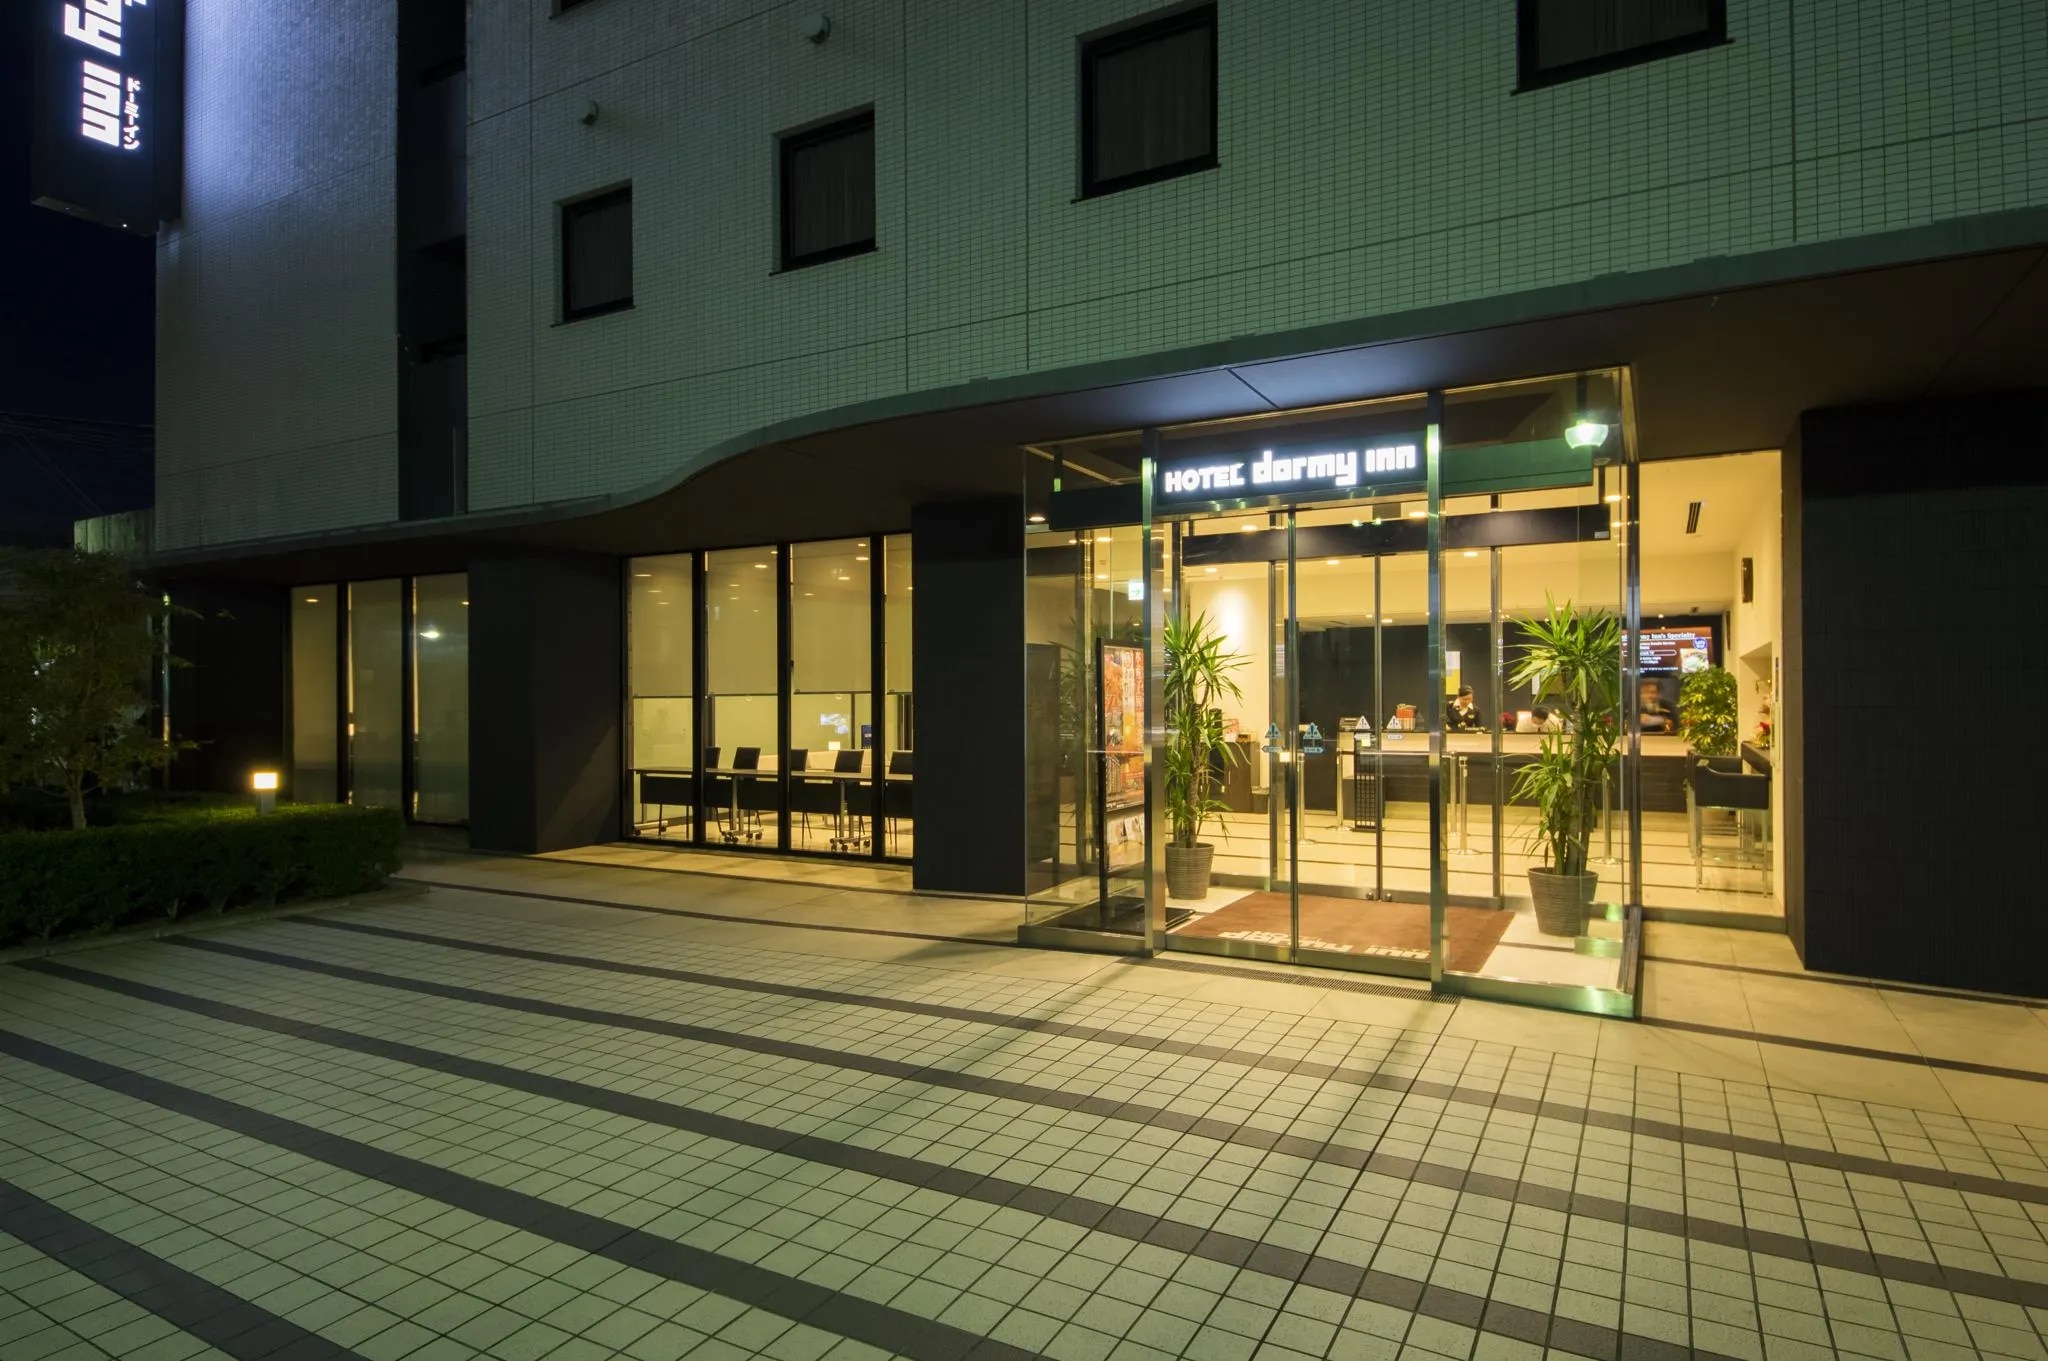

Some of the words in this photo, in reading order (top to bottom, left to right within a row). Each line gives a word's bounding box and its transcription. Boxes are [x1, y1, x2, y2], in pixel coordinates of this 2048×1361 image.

[123, 77, 141, 150] ドーミーイン
[1165, 463, 1245, 493] HOTEL
[1252, 450, 1357, 487] dormy
[1365, 445, 1416, 473] inn
